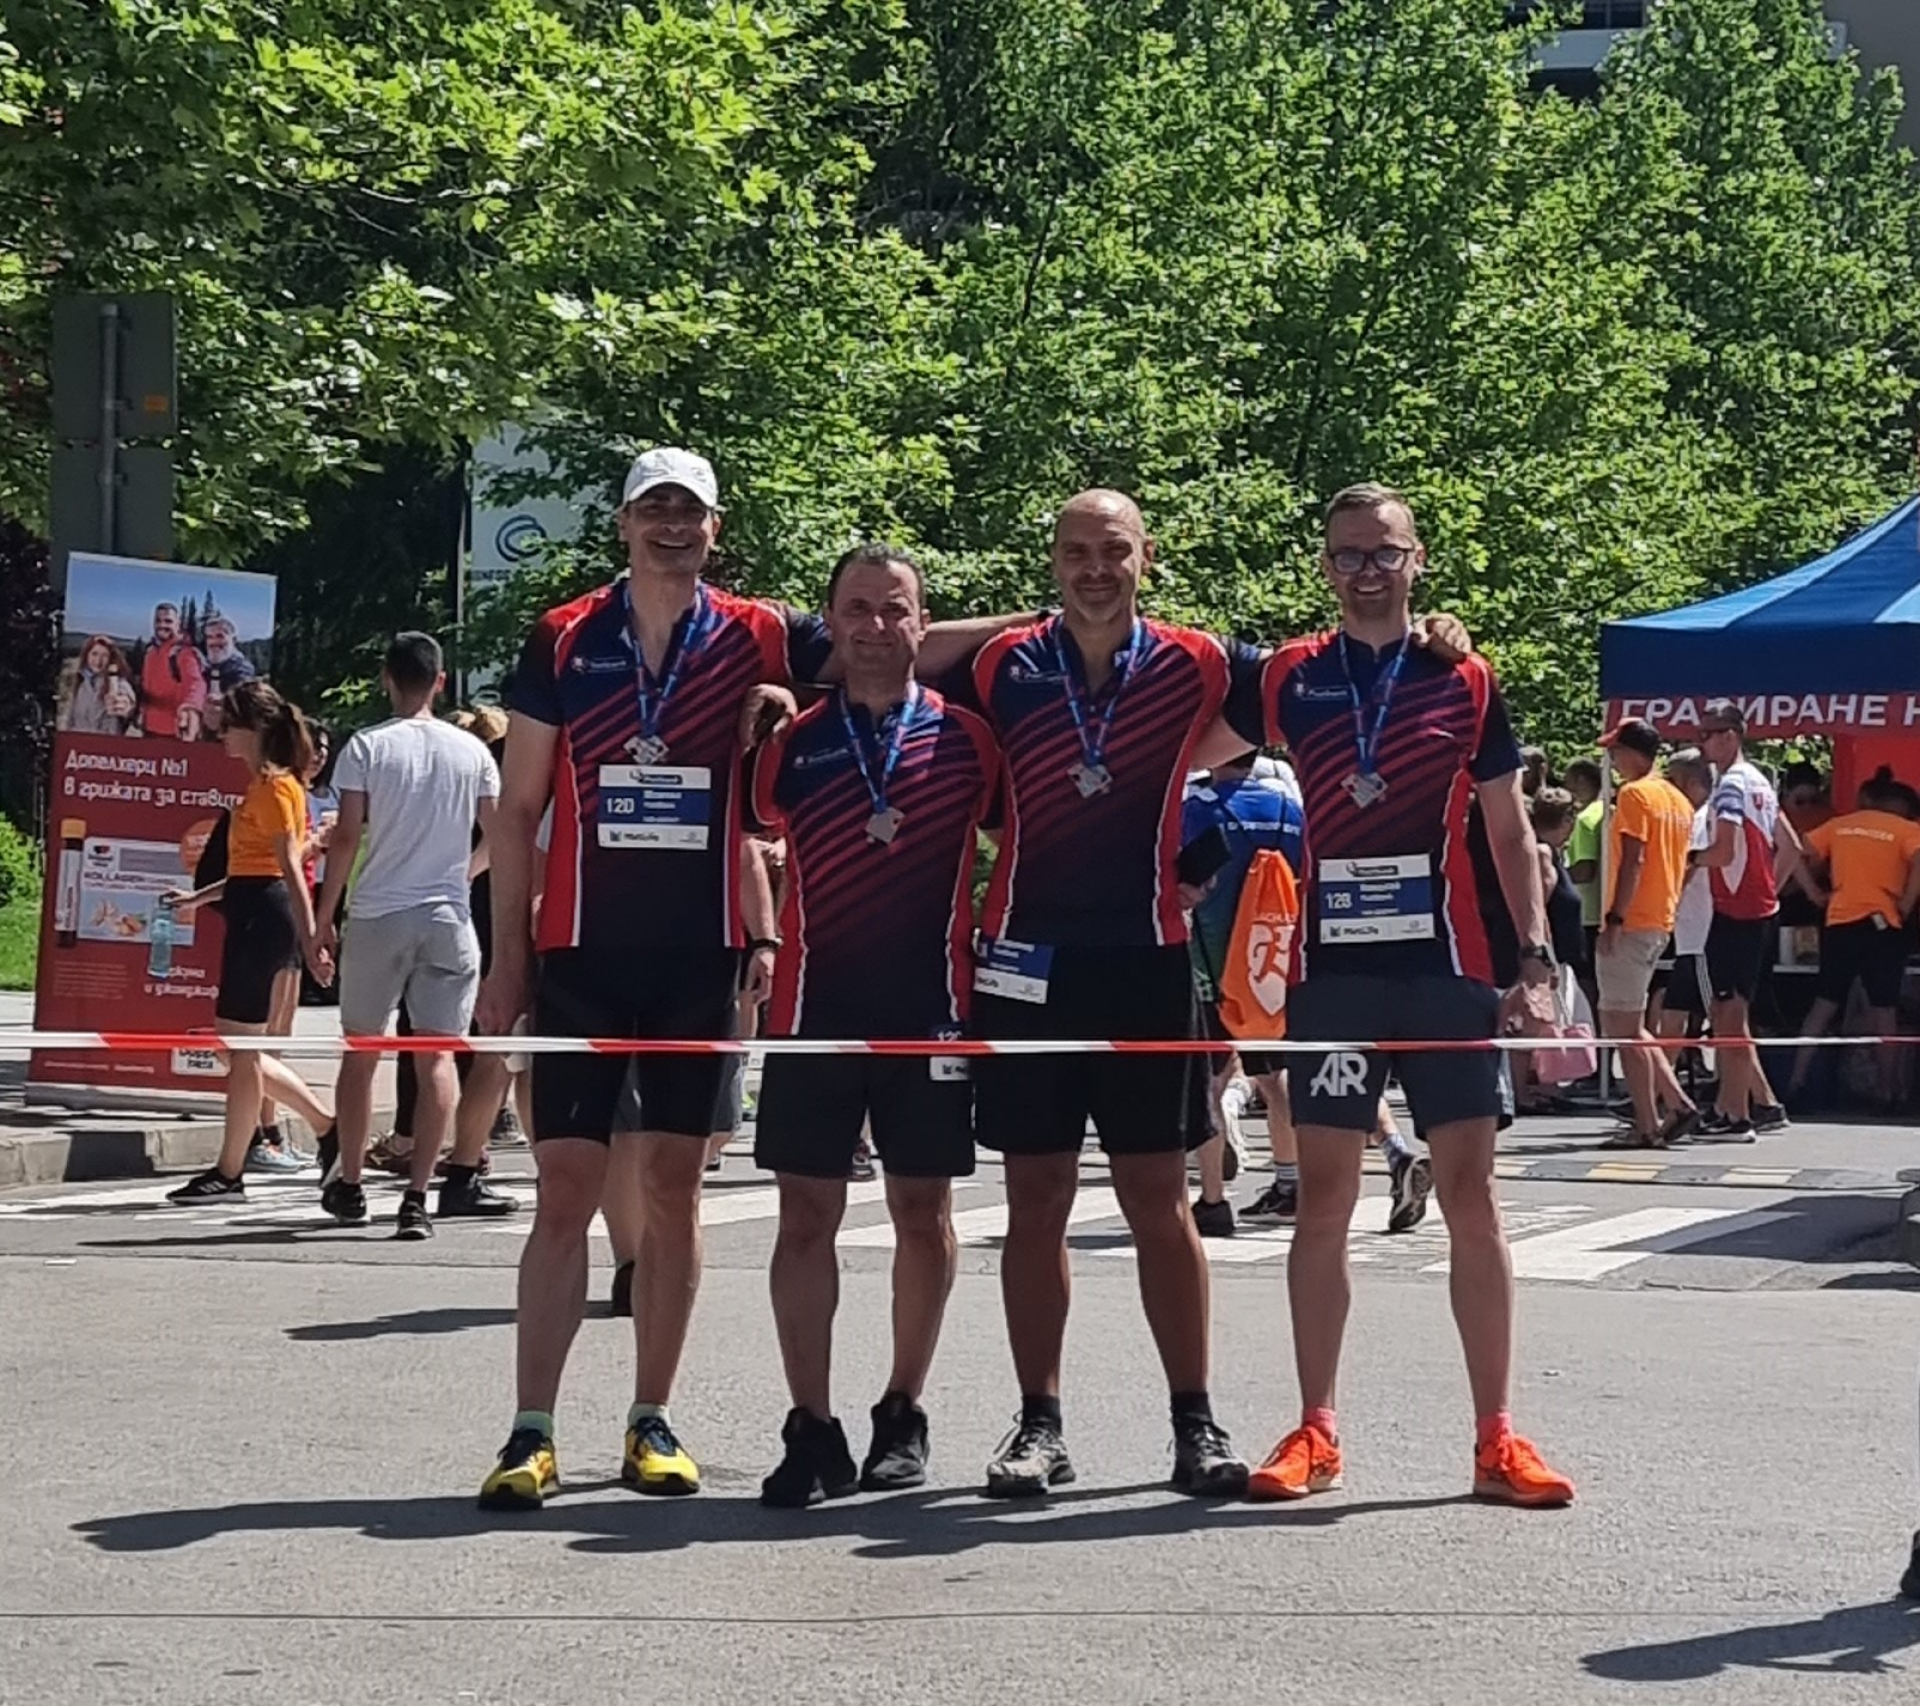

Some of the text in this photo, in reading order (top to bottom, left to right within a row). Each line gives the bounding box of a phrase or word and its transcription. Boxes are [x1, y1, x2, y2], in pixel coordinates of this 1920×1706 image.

[161, 758, 188, 777] №1
[79, 781, 151, 800] грижата
[155, 788, 176, 806] за
